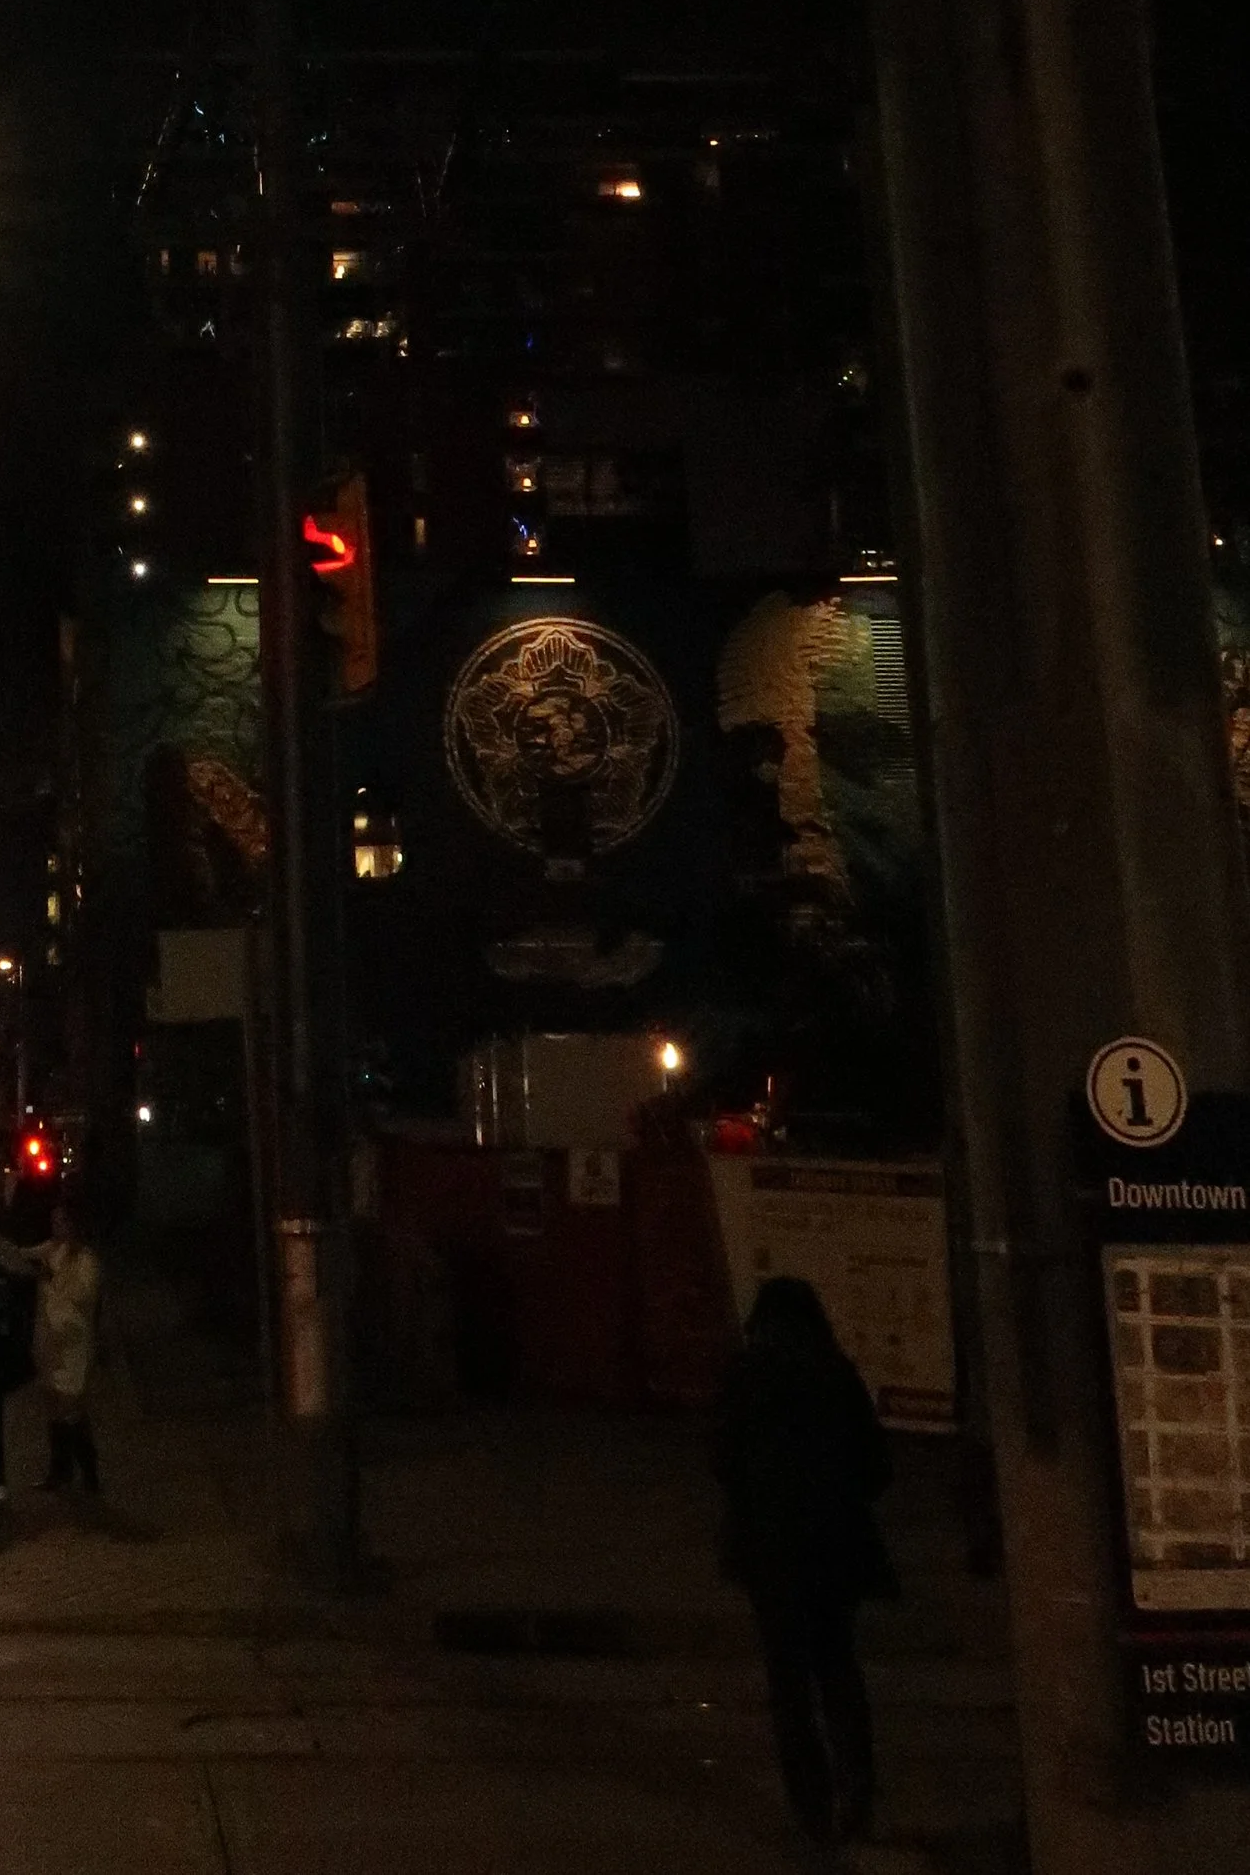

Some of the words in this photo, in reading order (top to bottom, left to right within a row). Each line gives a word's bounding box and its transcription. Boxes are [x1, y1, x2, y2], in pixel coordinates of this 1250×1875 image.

[1108, 1176, 1246, 1210] Downtown
[1141, 1663, 1178, 1694] 1st
[1147, 1713, 1235, 1746] Station
